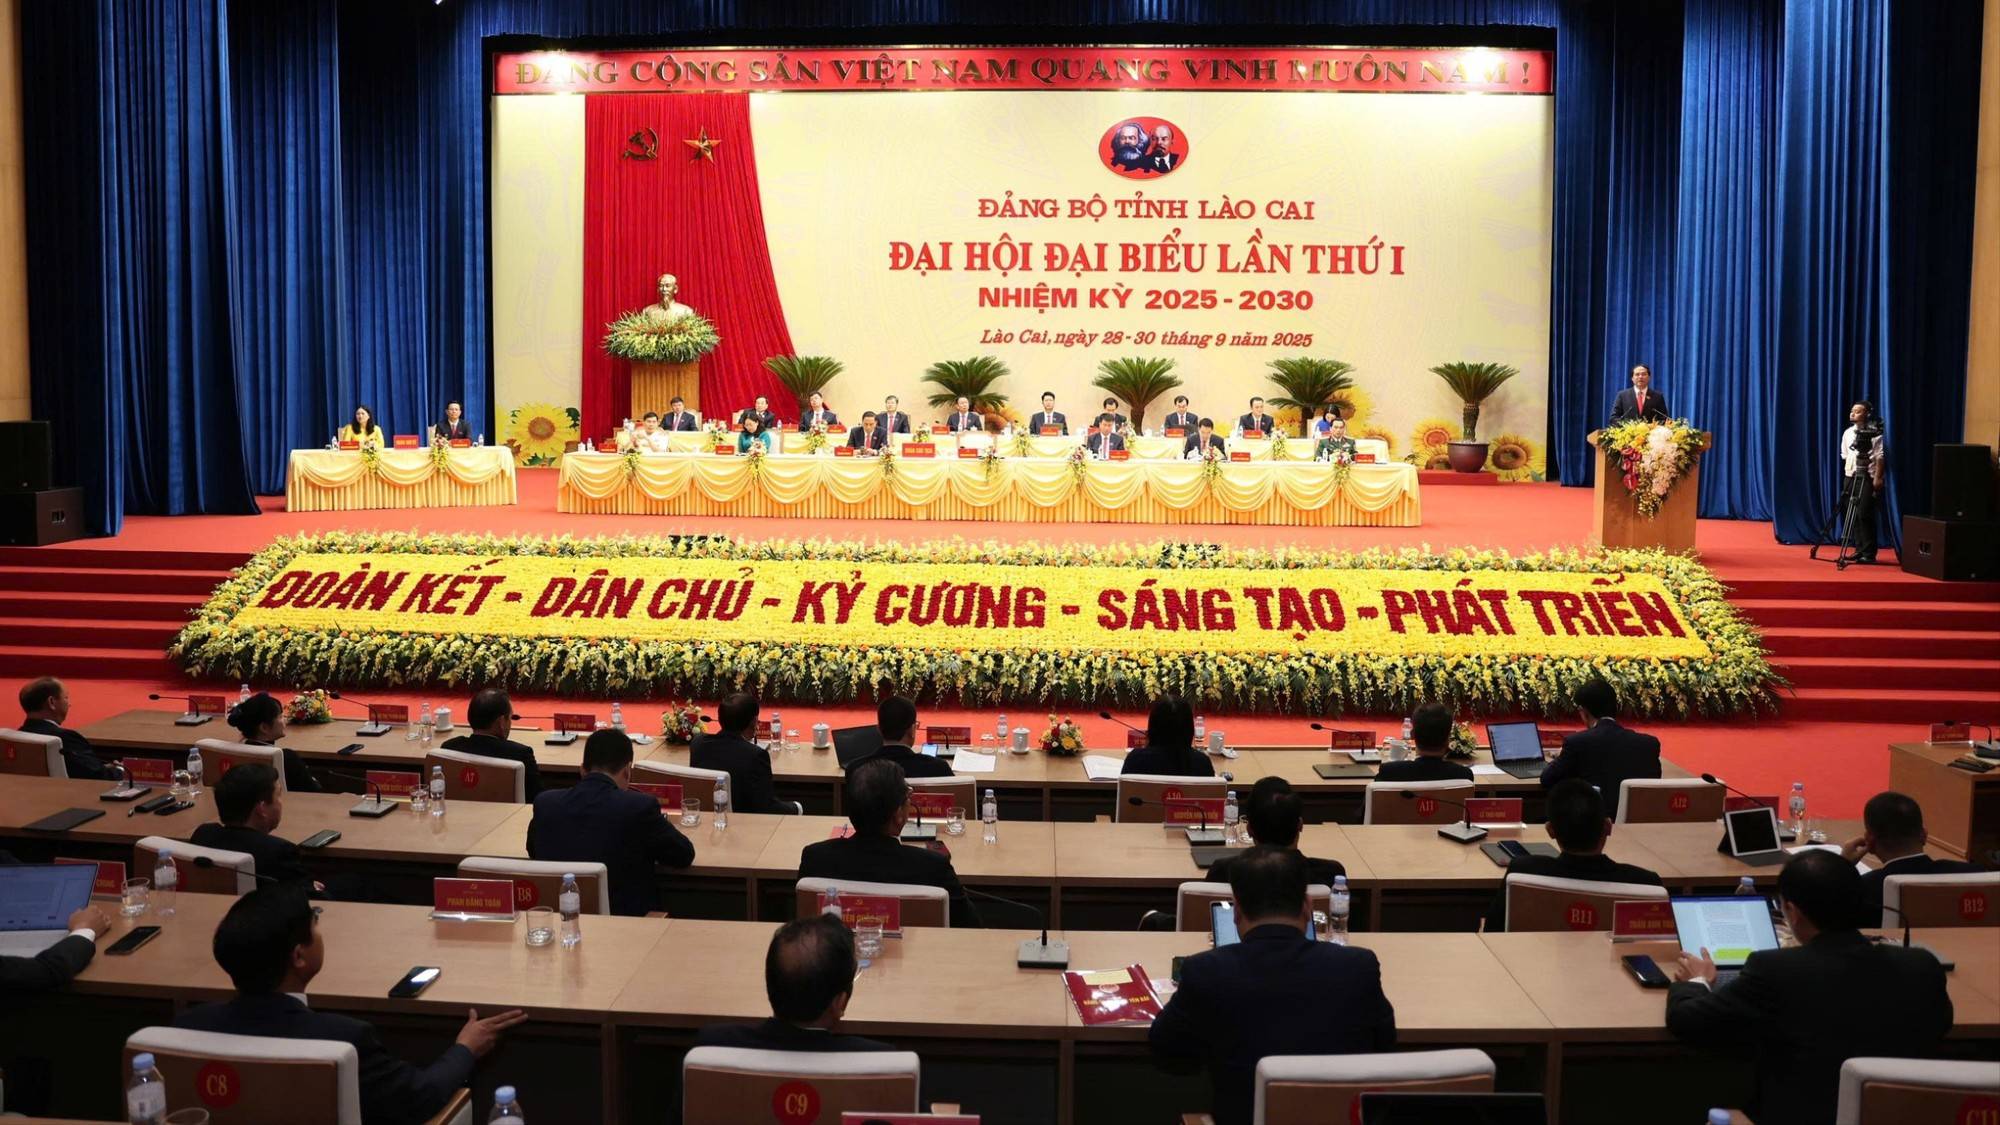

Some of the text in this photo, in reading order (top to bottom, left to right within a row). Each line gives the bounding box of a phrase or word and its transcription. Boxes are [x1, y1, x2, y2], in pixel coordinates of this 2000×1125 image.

[630, 54, 737, 87] CỘNG
[749, 53, 820, 83] SẢN
[830, 53, 921, 87] VIỆT
[931, 58, 1018, 82] NAM
[1031, 58, 1169, 84] QUANG
[1183, 58, 1278, 82] VINH
[1289, 53, 1409, 83] MUÔN
[978, 191, 1314, 221] ĐẢNG BỘ TỈNH LÀO CAI
[889, 228, 1405, 278] ĐẠI HỘI ĐẠI BIỂU LẦN THỨ I
[978, 282, 1078, 313] NHIỆM
[1089, 283, 1133, 308] KỲ
[1145, 289, 1218, 310] 2025
[1239, 290, 1314, 311] 2030
[980, 329, 1014, 344] Lào
[1054, 329, 1098, 347] ngày
[1161, 331, 1213, 349] tháng
[1215, 333, 1226, 346] 9
[1229, 331, 1268, 346] năm
[1272, 332, 1313, 347] 2025
[399, 558, 505, 615] KẾT
[530, 568, 645, 619] DÂN
[646, 566, 754, 622] CHỦ
[792, 570, 866, 625] KỶ
[875, 580, 1046, 629] CƯƠNG
[1097, 579, 1237, 632] SÁNG
[1243, 587, 1346, 640] TẠO
[1382, 578, 1518, 637] PHÁT
[1518, 572, 1688, 638] TRIỂN
[1419, 800, 1435, 812] A11
[517, 888, 532, 901] B8
[1963, 898, 1984, 913] B12
[1571, 908, 1593, 925] B11
[206, 1075, 227, 1096] C8
[785, 1093, 808, 1116] C9
